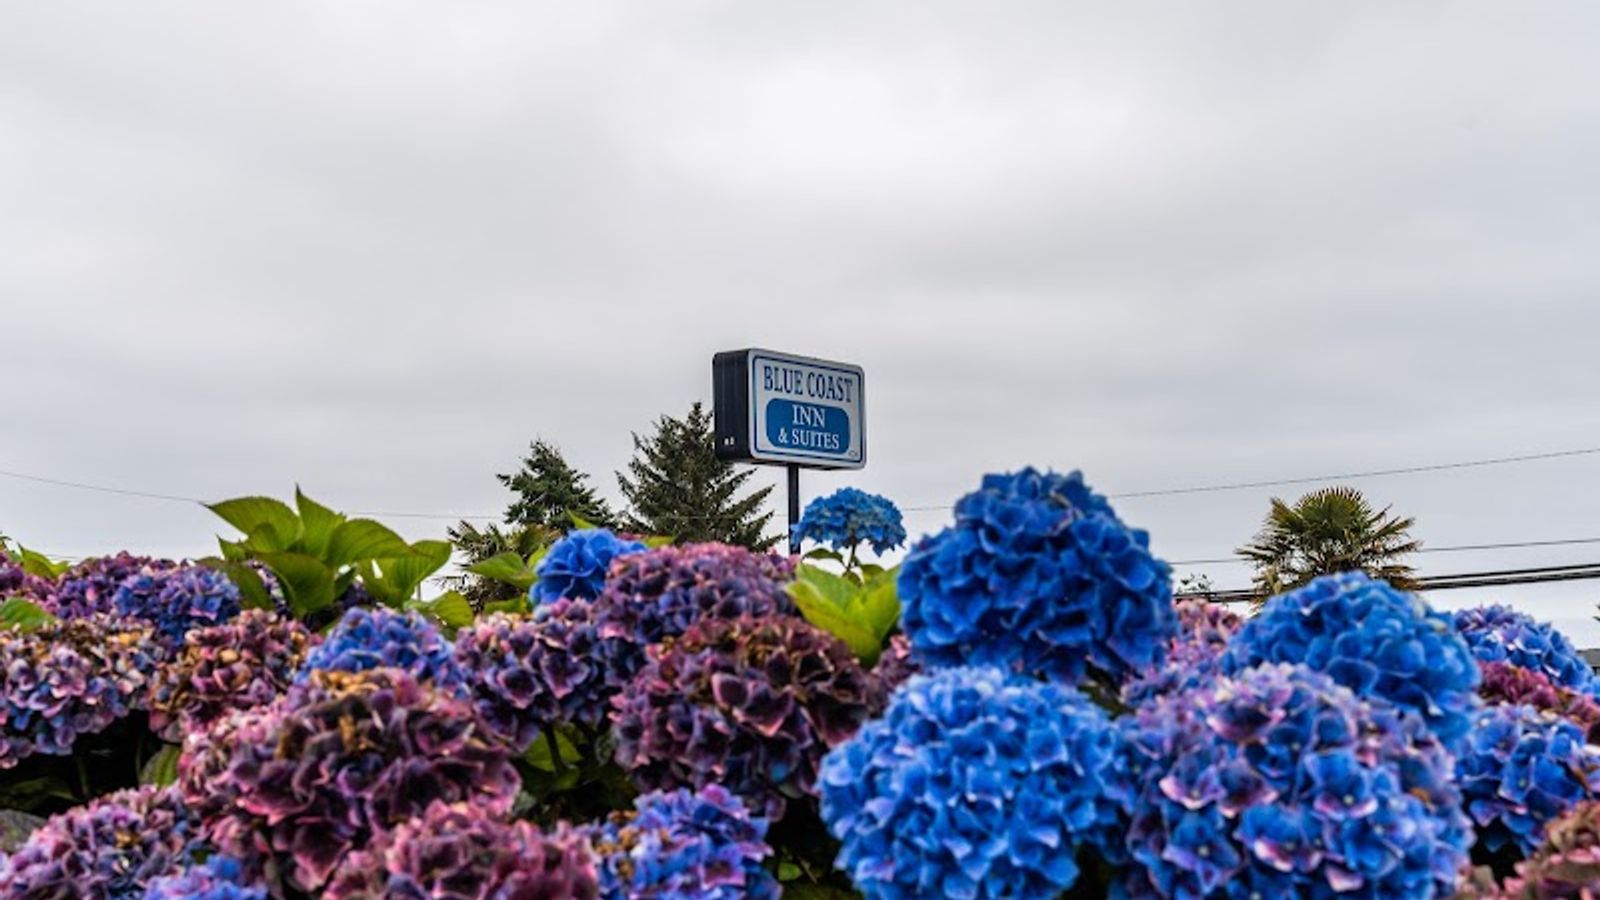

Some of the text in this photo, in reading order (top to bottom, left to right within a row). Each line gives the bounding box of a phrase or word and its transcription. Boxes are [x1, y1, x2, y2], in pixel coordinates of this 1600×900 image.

[764, 366, 853, 403] BLUE COAST
[792, 404, 825, 428] INN
[778, 427, 840, 449] & SUITES
